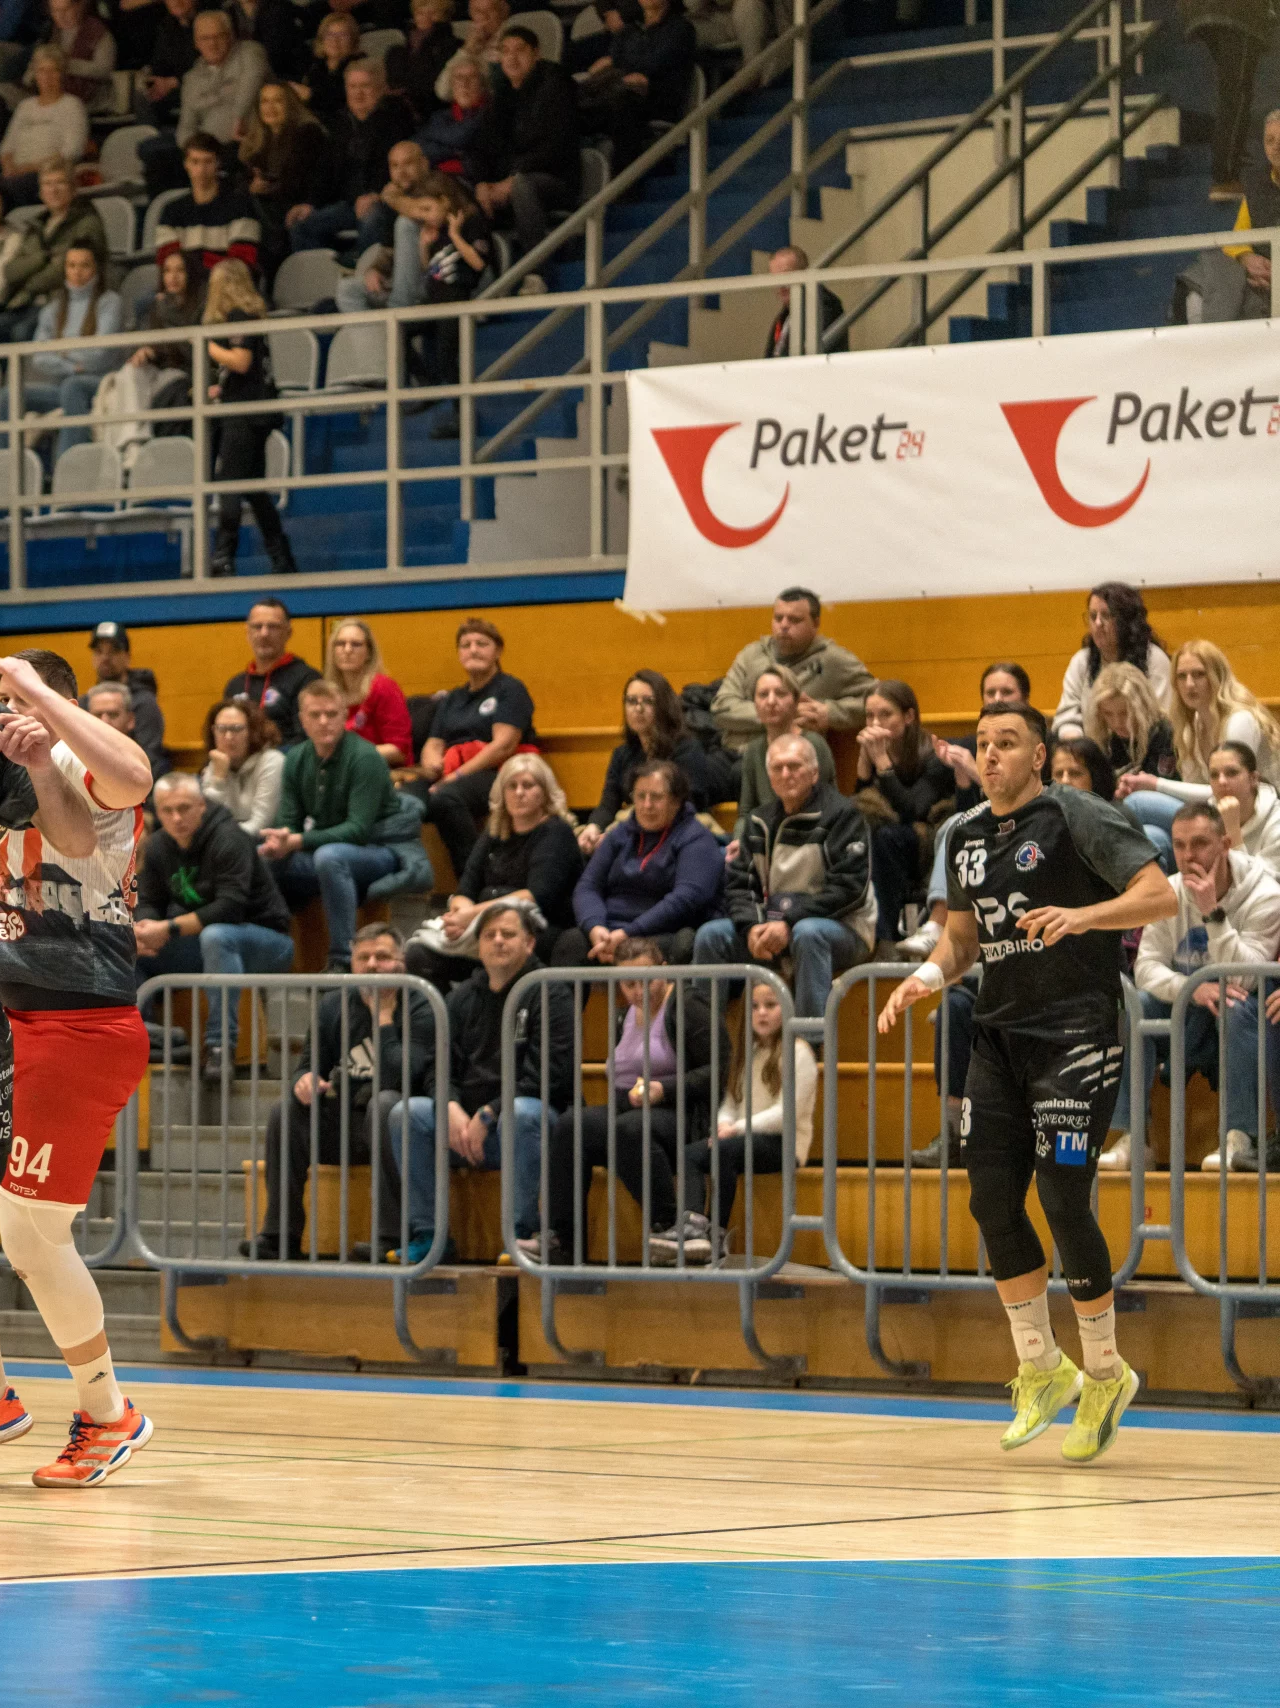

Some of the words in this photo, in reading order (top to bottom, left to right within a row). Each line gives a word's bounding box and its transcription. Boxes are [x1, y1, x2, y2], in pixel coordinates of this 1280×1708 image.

[1106, 386, 1279, 445] Paket
[749, 412, 908, 470] Paket
[895, 430, 925, 460] 24
[955, 848, 988, 890] 33
[8, 1135, 54, 1184] 94
[1056, 1130, 1089, 1152] TM
